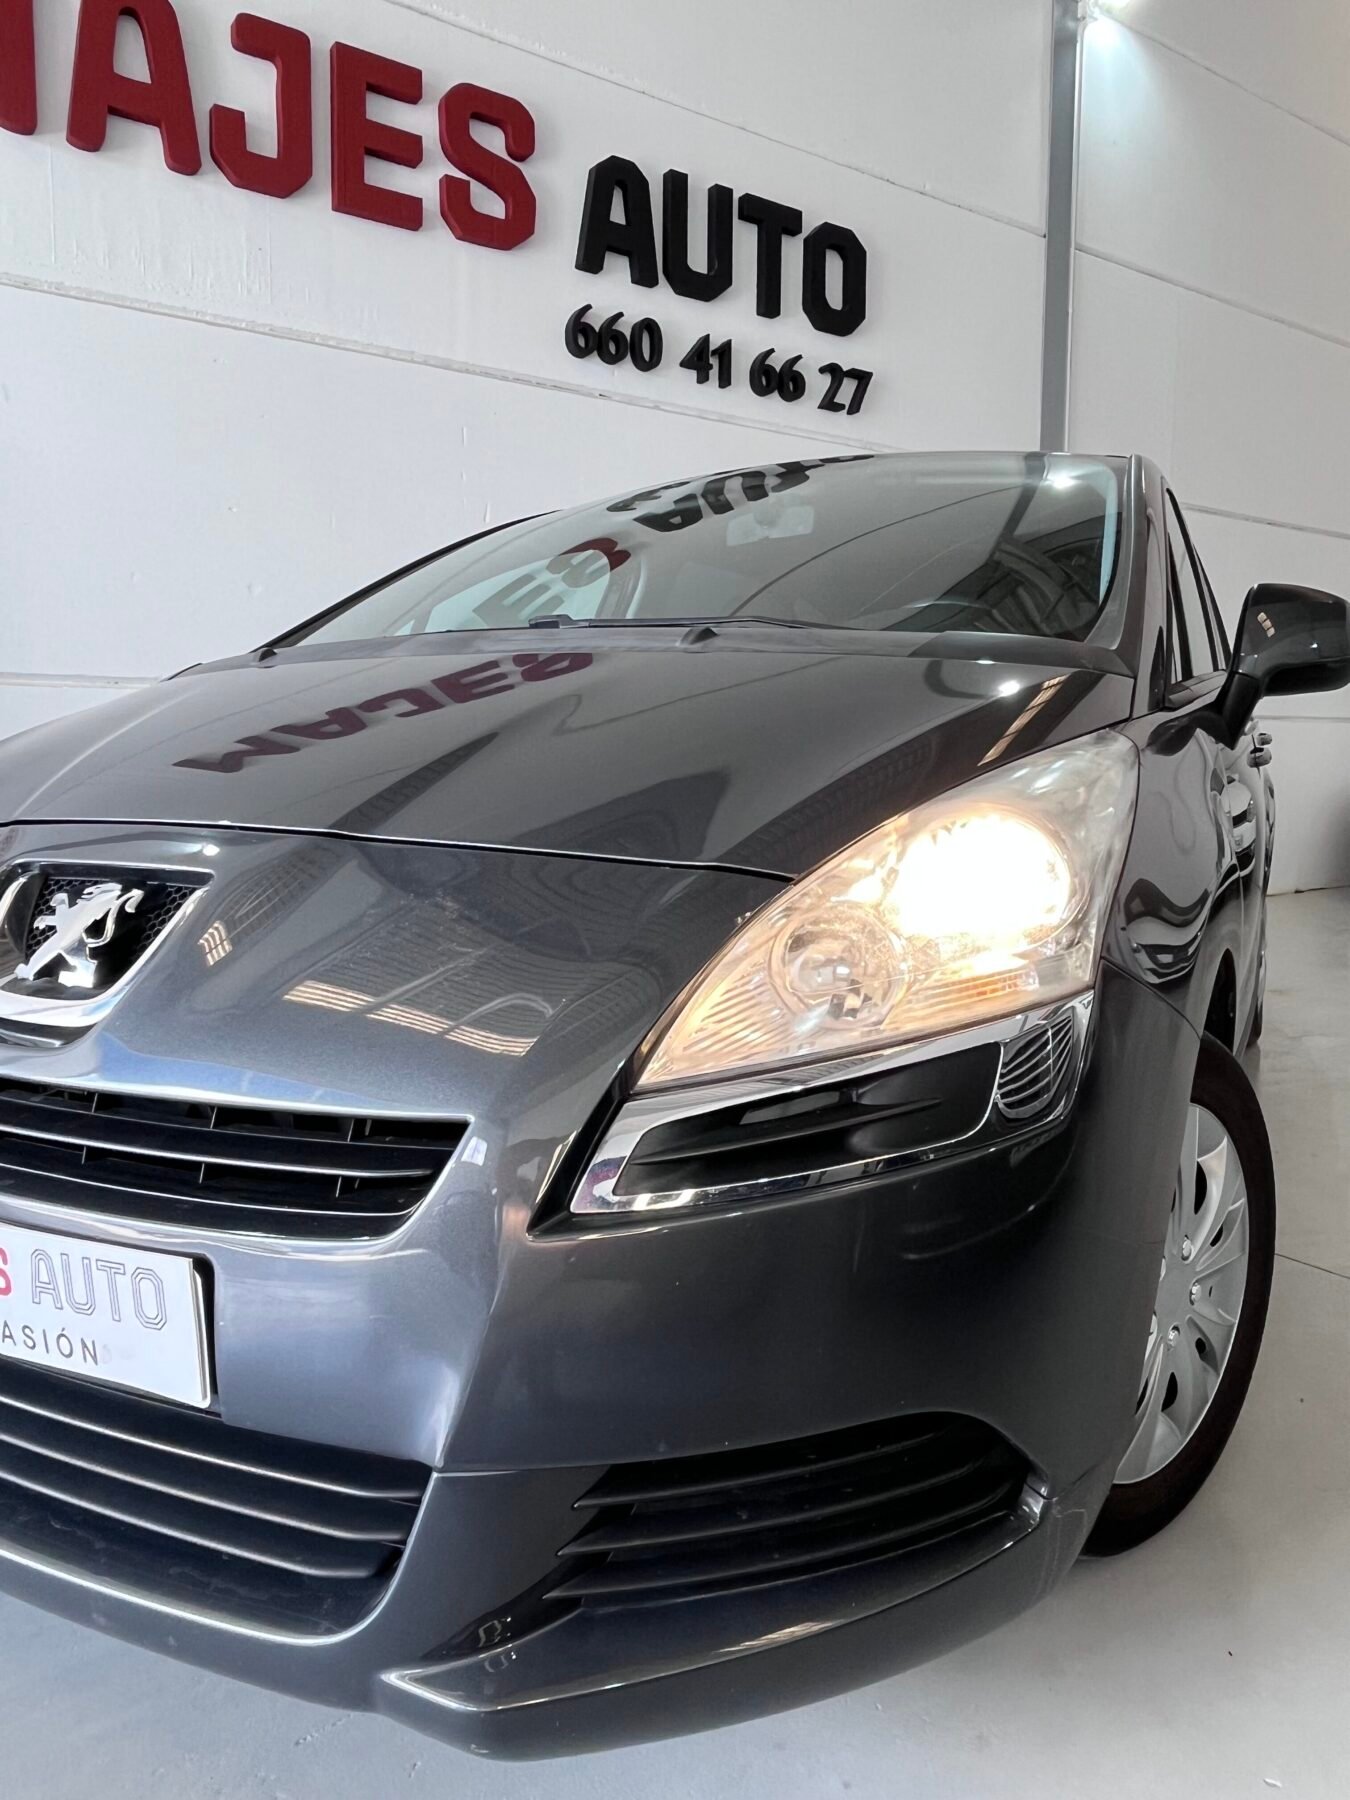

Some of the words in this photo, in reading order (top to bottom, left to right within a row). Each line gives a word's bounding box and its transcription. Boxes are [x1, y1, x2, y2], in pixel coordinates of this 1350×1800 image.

[575, 155, 867, 337] AUTO
[565, 304, 663, 372] 660
[680, 334, 732, 389] 41
[749, 348, 806, 402] 66
[818, 362, 873, 415] 27
[31, 1249, 168, 1331] AUTO
